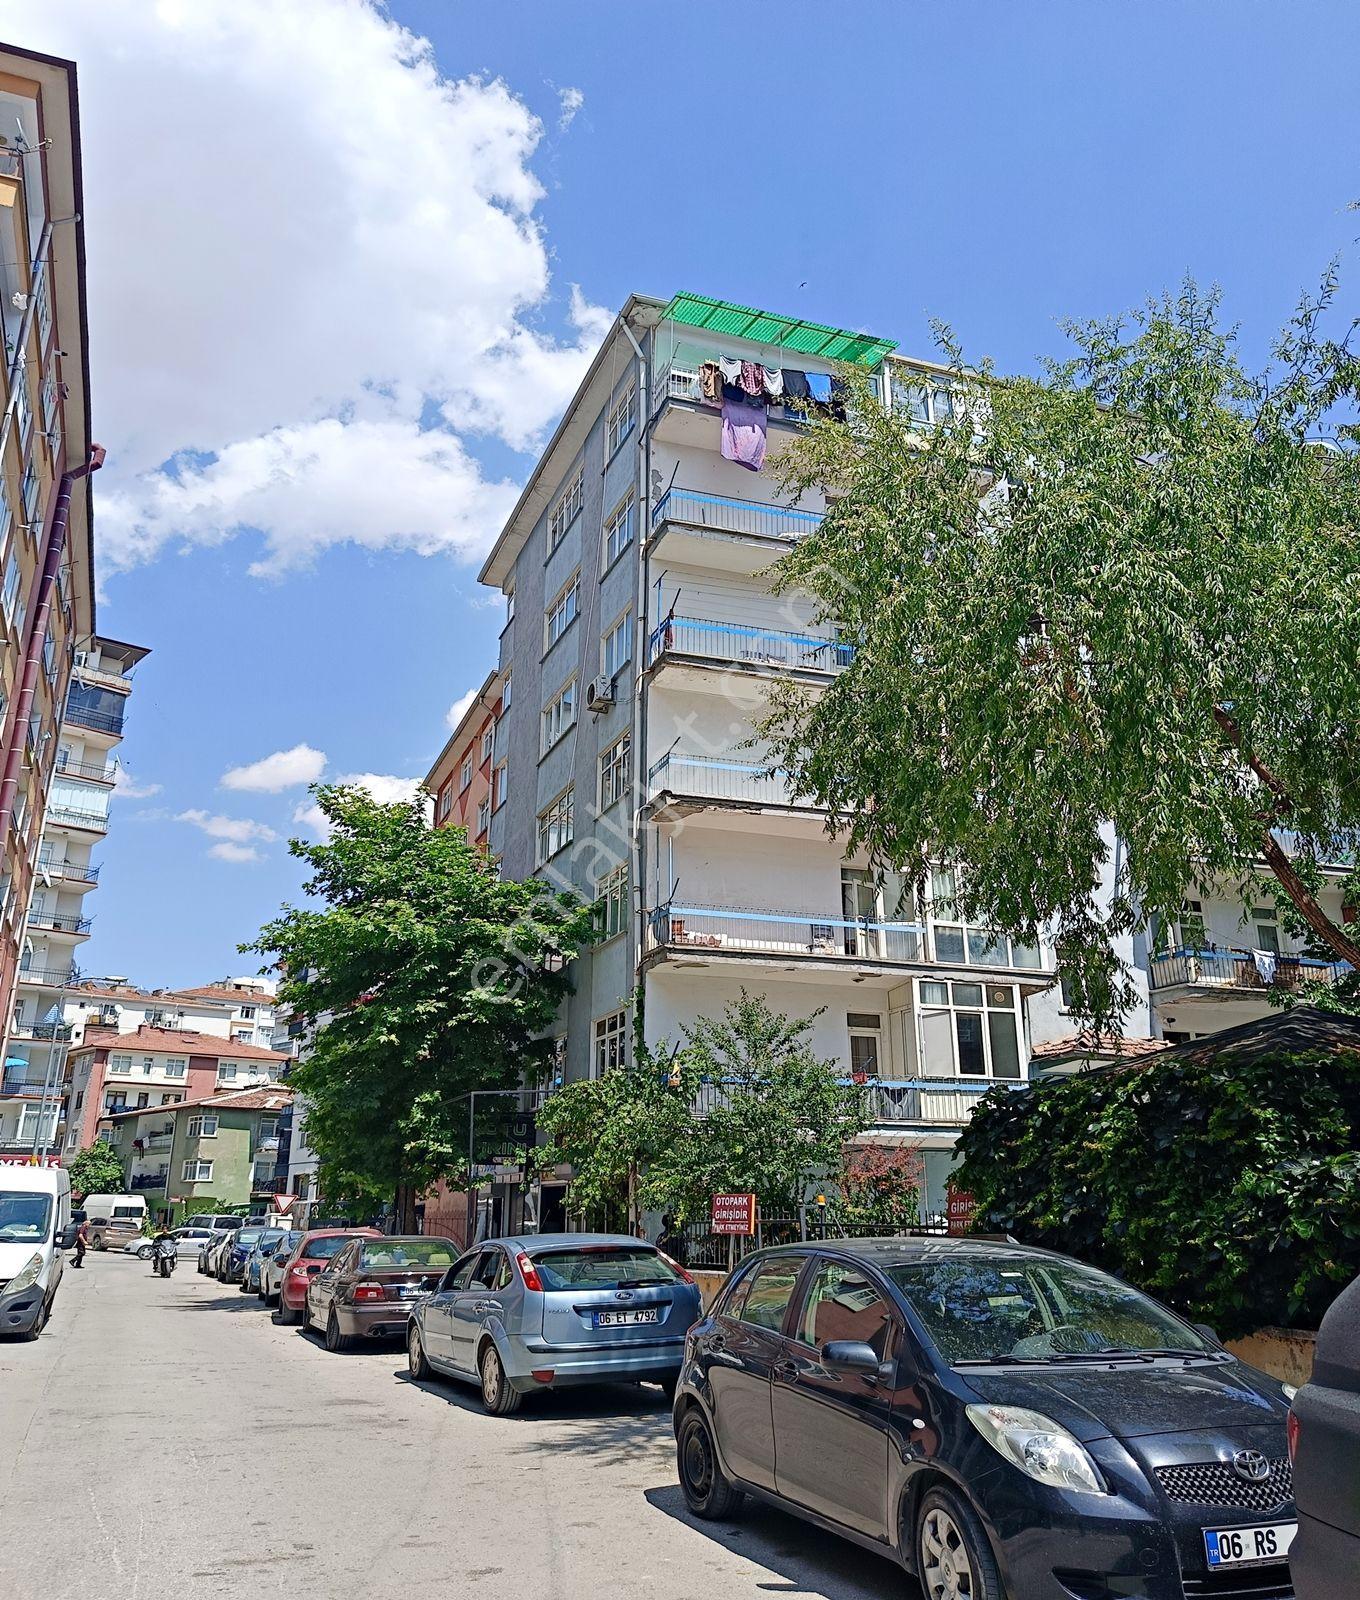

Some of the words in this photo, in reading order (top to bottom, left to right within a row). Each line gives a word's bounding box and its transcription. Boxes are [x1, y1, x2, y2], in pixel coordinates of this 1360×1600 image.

[716, 1197, 748, 1206] OTOPARK
[715, 1209, 748, 1221] GİRİŞİDİR
[599, 1313, 611, 1325] 06
[616, 1312, 628, 1323] ET
[634, 1311, 656, 1323] 4792
[1219, 1532, 1243, 1560] 06
[1254, 1529, 1277, 1557] RS
[1210, 1549, 1219, 1557] TR
